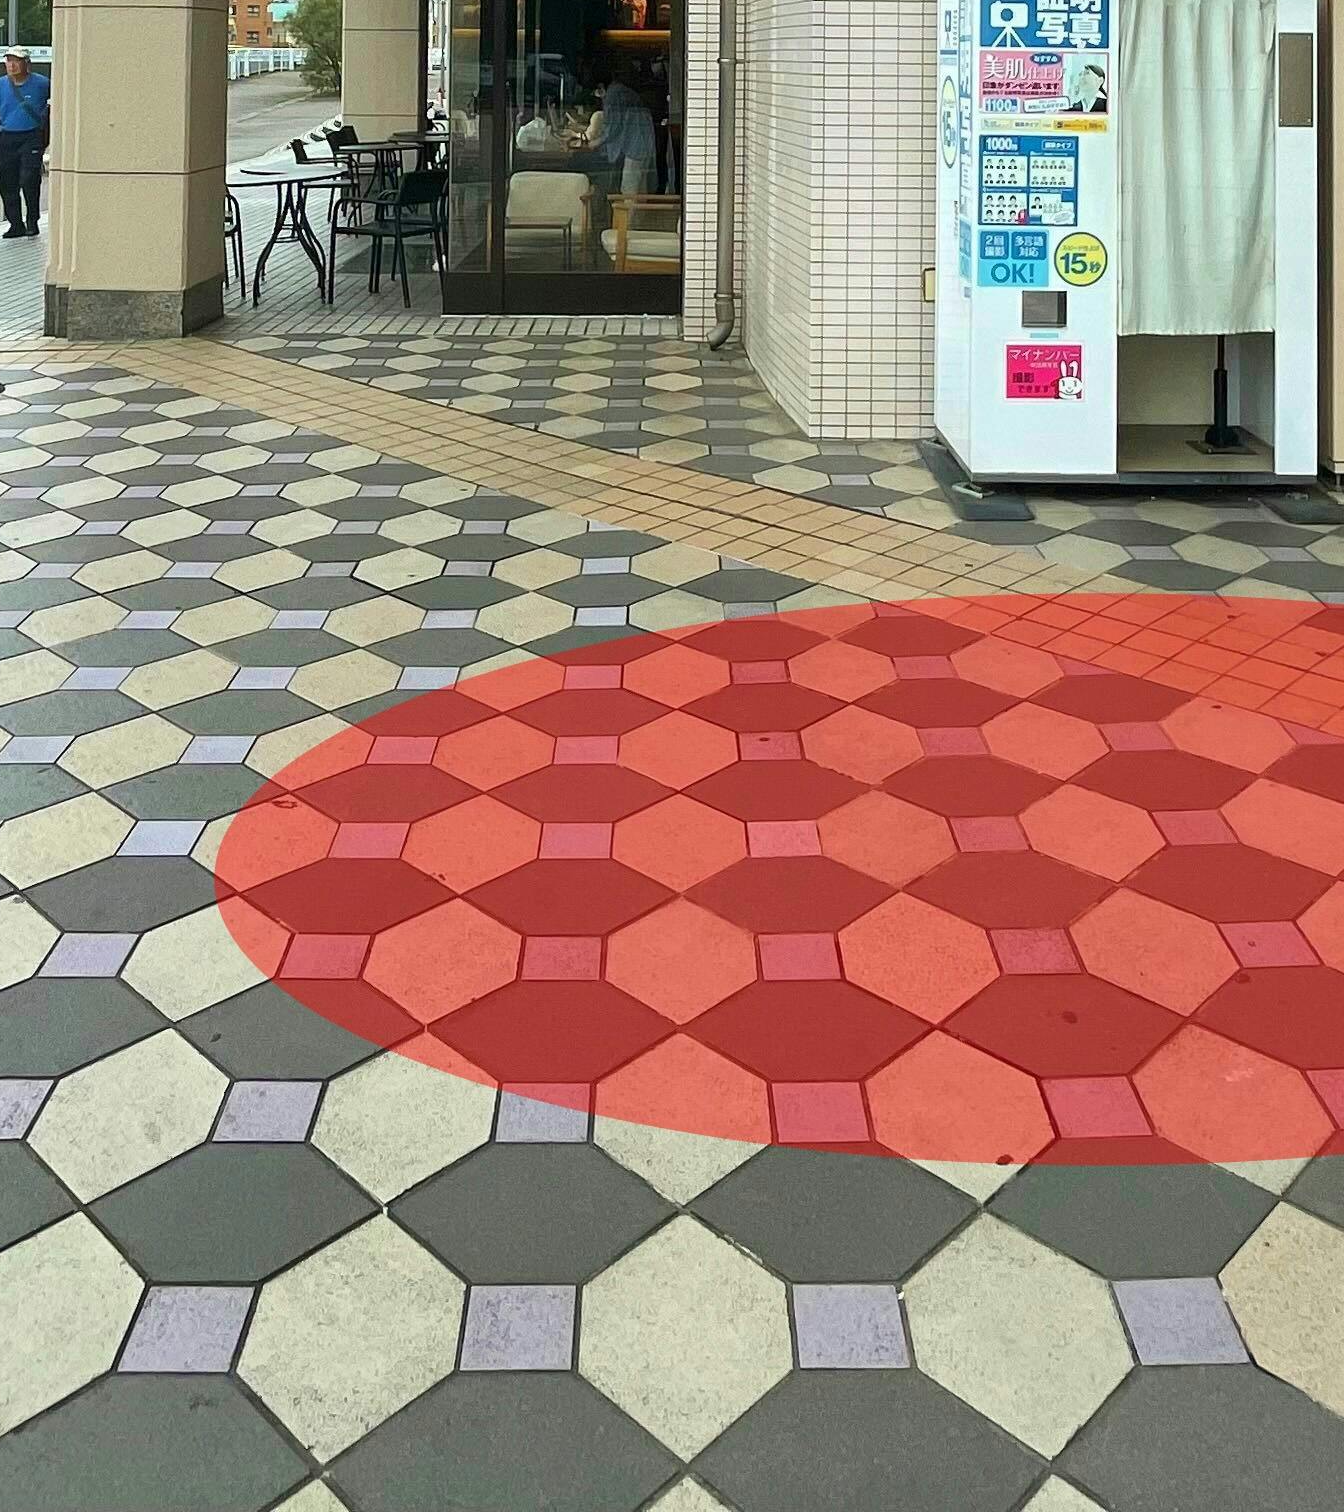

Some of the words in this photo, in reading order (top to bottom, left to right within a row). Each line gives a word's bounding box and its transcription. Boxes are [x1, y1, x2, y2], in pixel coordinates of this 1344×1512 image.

[1036, 12, 1102, 48] 写真
[1015, 235, 1044, 247] 多言語
[1018, 246, 1040, 257] 対応
[1060, 252, 1102, 275] 15秒
[990, 262, 1035, 284] OK!
[1008, 349, 1080, 361] マイナンバー
